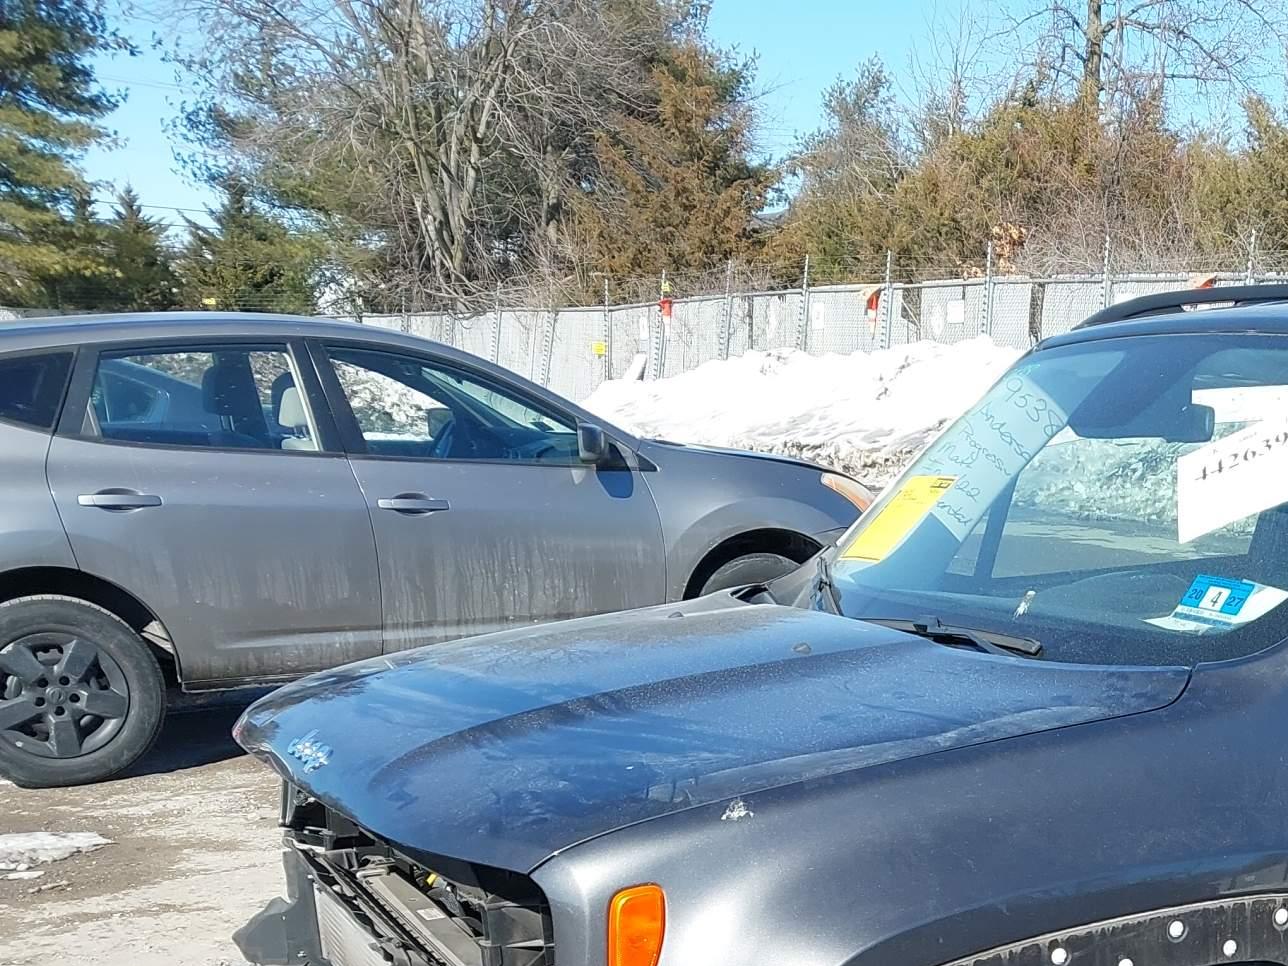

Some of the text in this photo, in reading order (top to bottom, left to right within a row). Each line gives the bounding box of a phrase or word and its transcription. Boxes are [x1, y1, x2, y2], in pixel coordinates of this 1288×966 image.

[1187, 588, 1243, 608] 20 4 27
